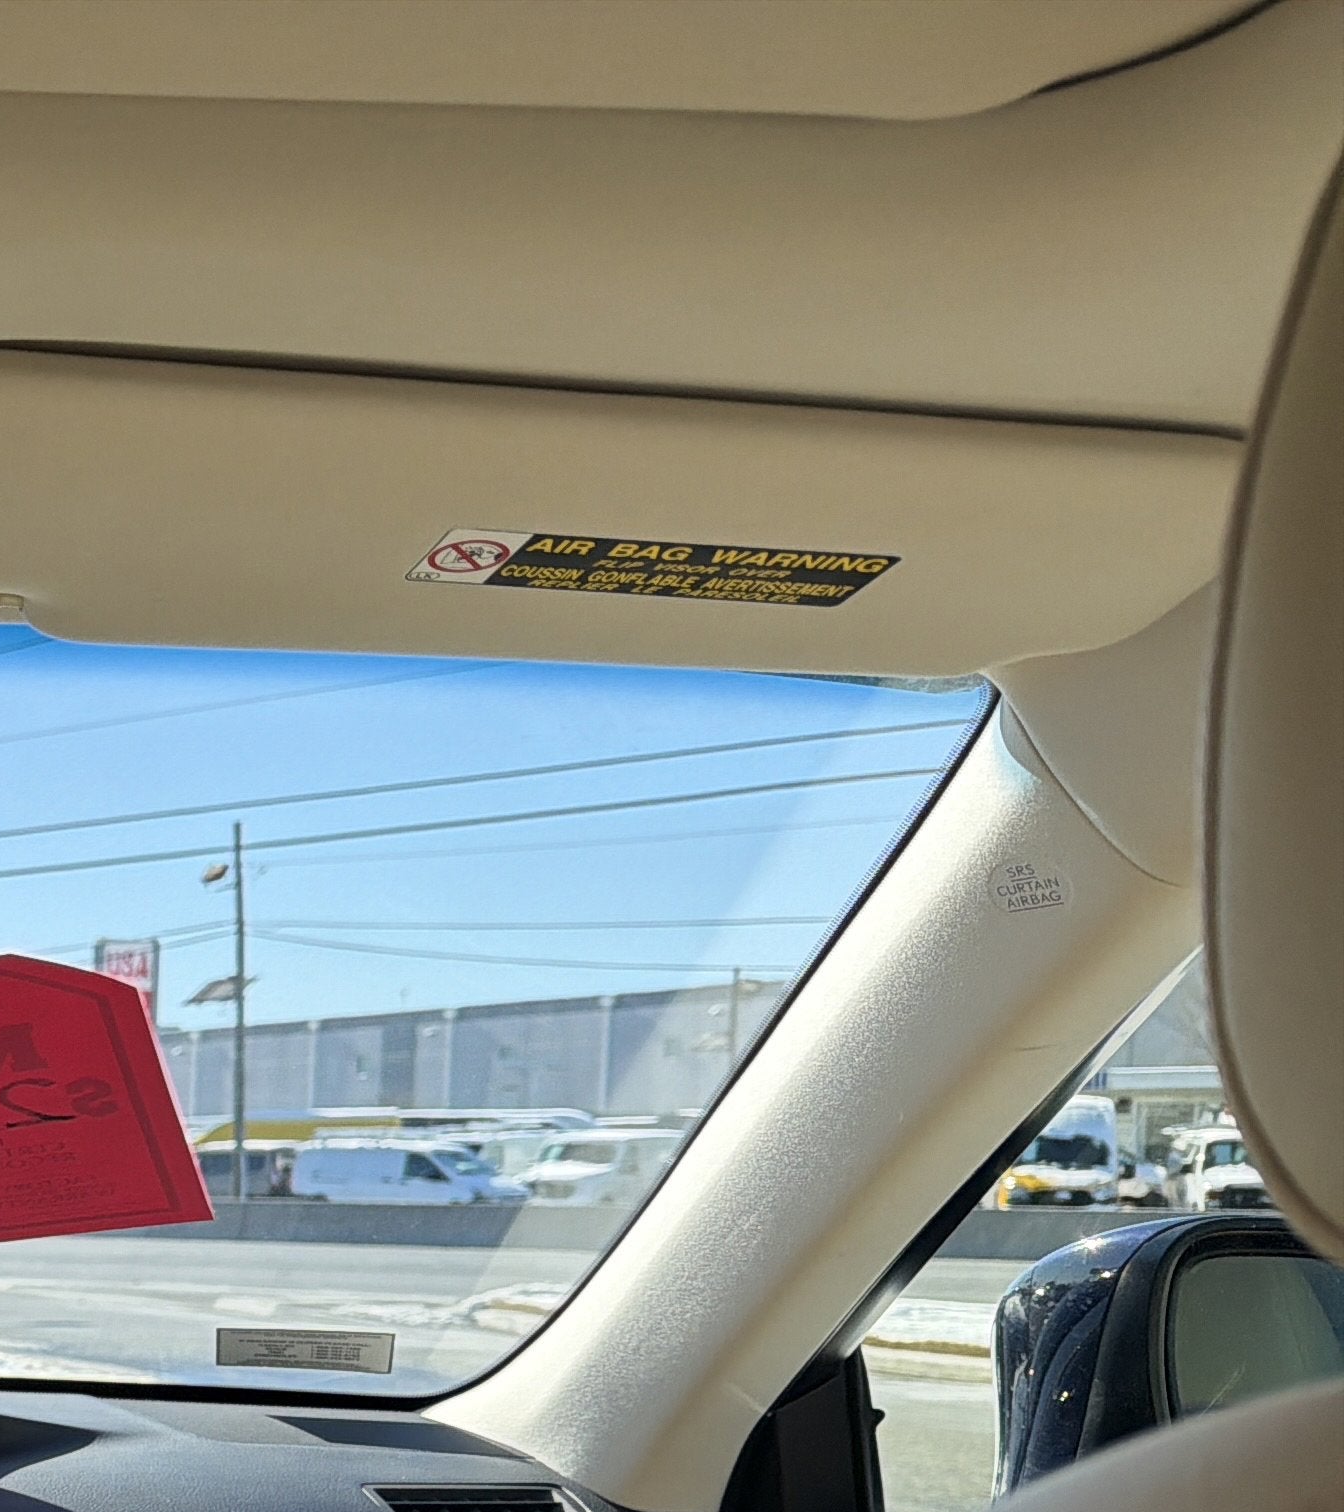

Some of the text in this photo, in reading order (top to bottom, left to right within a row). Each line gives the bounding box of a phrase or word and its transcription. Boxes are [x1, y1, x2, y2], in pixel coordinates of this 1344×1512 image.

[526, 538, 890, 574] AIR BAG WARNING
[591, 559, 792, 580] FLIP VISOR OVER
[500, 564, 855, 598] COUSSIN GONFLABLE AVERTISSEMENT
[528, 579, 620, 591] REPLIER
[630, 585, 658, 594] LE
[1006, 864, 1035, 878] SRS
[997, 877, 1060, 897] CURTAIN
[1008, 890, 1061, 909] AIRBAG
